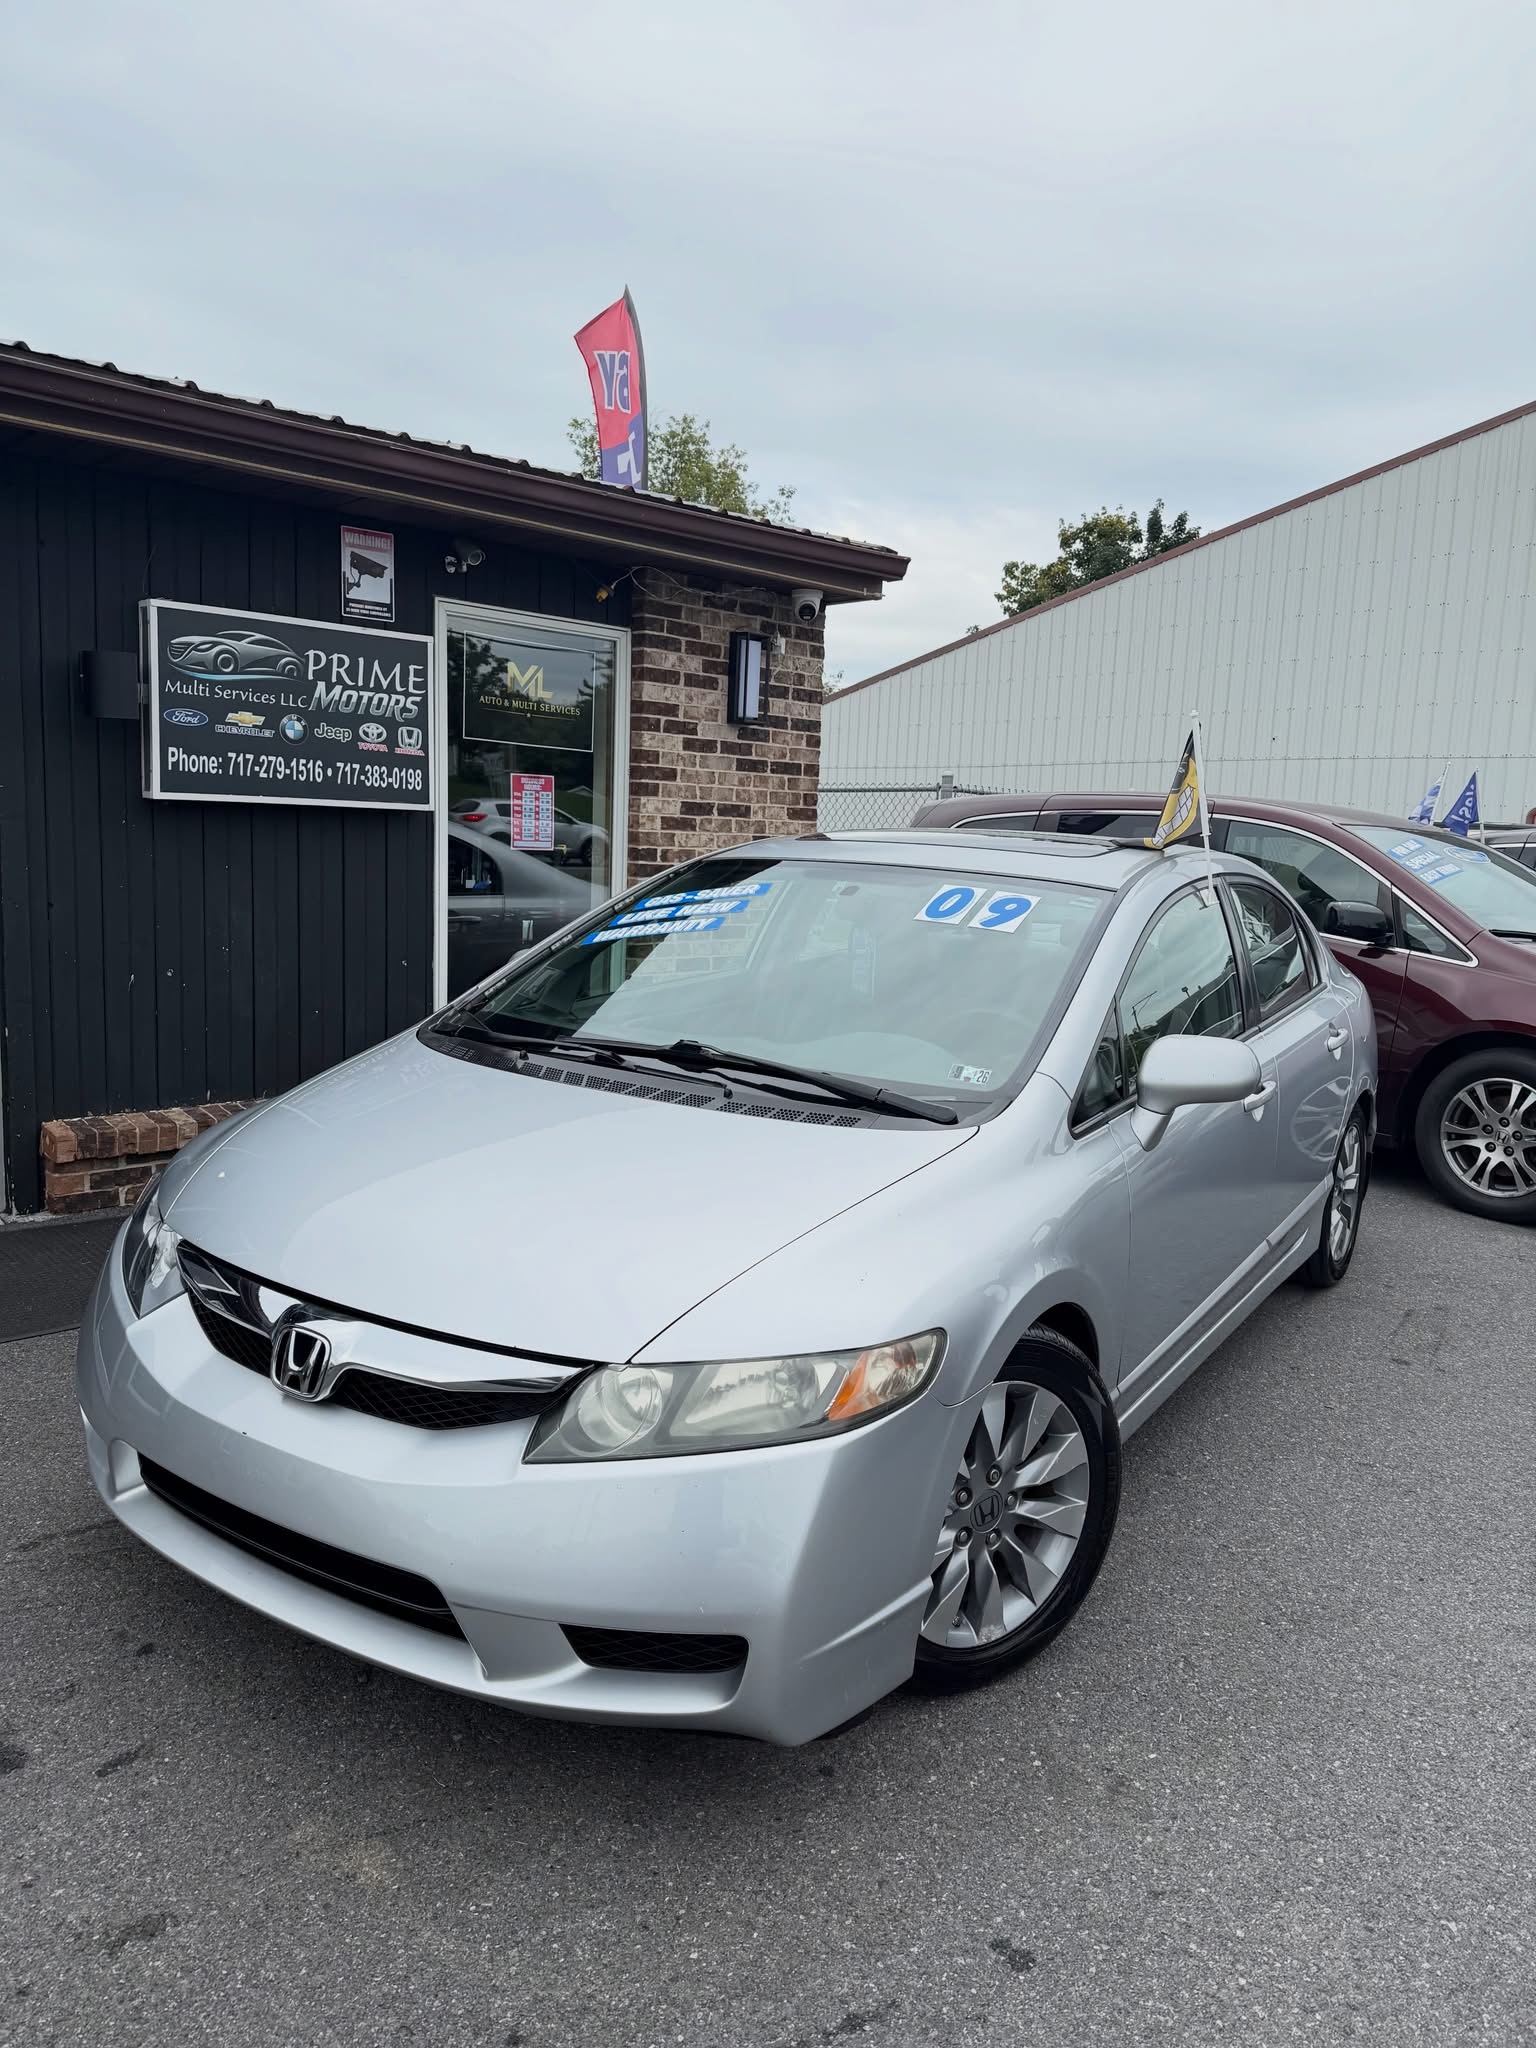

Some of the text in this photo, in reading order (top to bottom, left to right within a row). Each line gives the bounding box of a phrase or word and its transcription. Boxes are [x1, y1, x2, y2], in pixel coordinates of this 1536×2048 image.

[304, 649, 427, 694] PRIME
[165, 679, 308, 709] Multi Services LLC
[308, 680, 423, 722] MOTORS
[479, 695, 581, 716] AUTO & MULTI SERVICES
[172, 710, 200, 724] Ford
[214, 724, 276, 738] CHEVROLET
[314, 722, 352, 742] Jeep
[357, 741, 389, 753] TOYOTA
[394, 747, 426, 757] HONDA
[168, 747, 423, 791] Phone: 717-279-1516 717-383-0198
[644, 883, 762, 908] GAS-SAVER
[616, 900, 742, 925] LIKE NEW
[592, 917, 718, 943] WARRANTY
